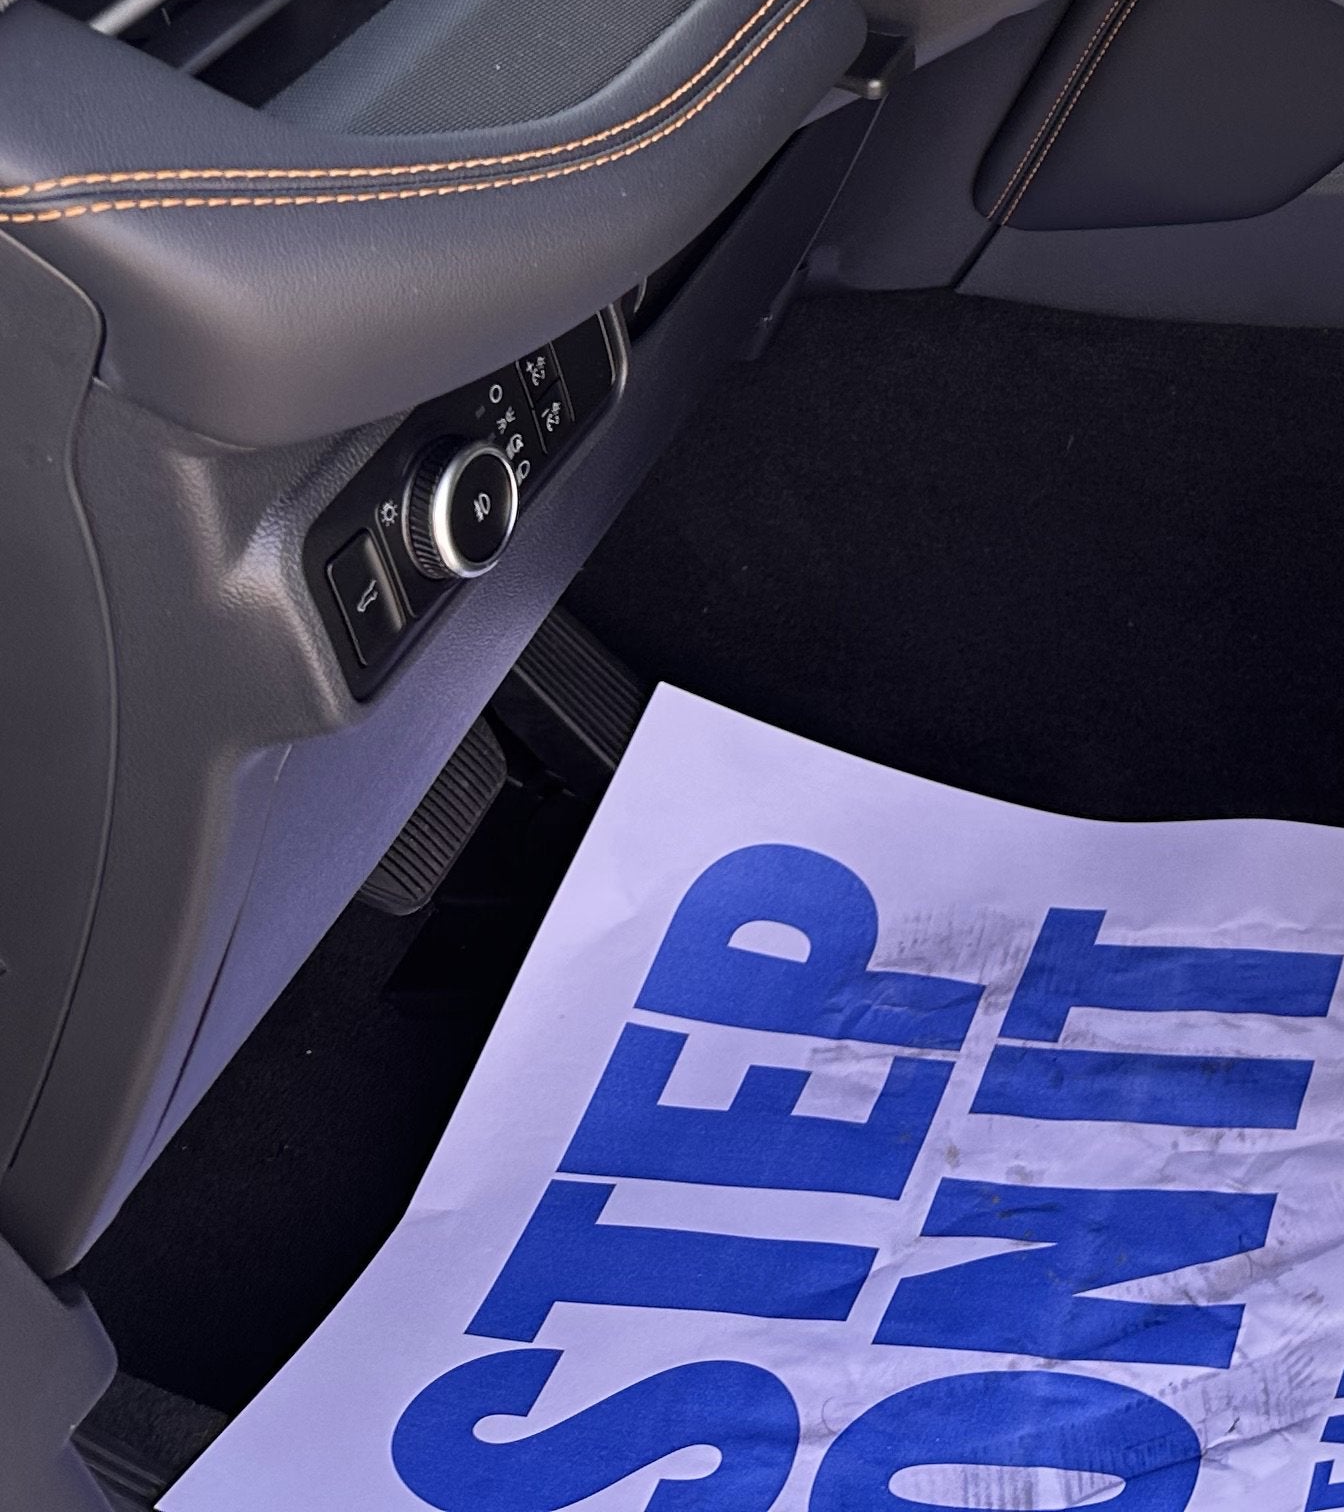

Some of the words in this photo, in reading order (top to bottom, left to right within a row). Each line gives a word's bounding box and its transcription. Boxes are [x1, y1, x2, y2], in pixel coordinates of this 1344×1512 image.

[391, 843, 987, 1512] STEP
[969, 908, 1344, 1130] IT
[808, 1178, 1278, 1512] ON
